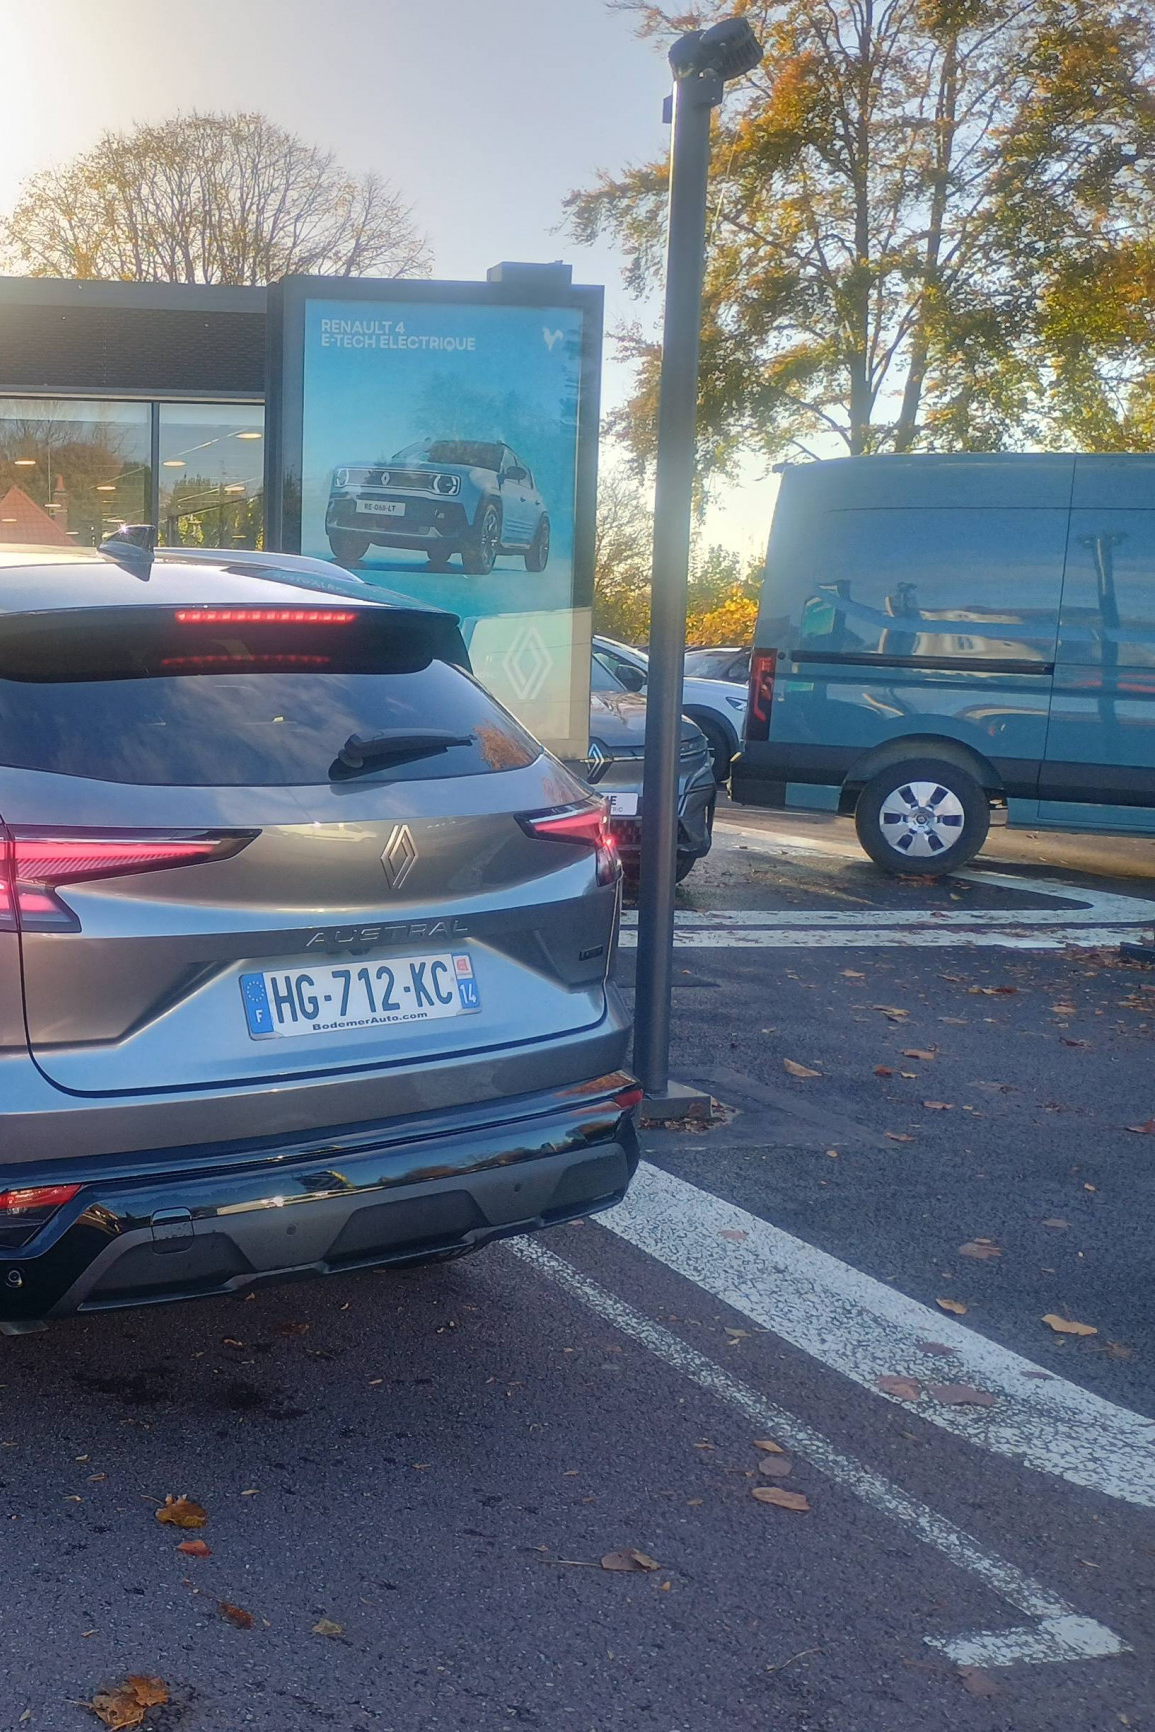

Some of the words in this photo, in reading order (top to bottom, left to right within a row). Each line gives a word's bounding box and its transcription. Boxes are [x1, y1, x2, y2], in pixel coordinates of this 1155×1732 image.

[321, 319, 393, 335] RENAULT
[395, 321, 406, 335] 4
[321, 333, 376, 348] E-TECH
[379, 335, 476, 351] ELECTRIQUE
[305, 919, 469, 947] AUSTRAL
[255, 1009, 264, 1023] F
[270, 960, 453, 1024] HG-712-KC
[459, 983, 477, 1004] 14
[312, 1011, 428, 1031] BodemerAuto.com
